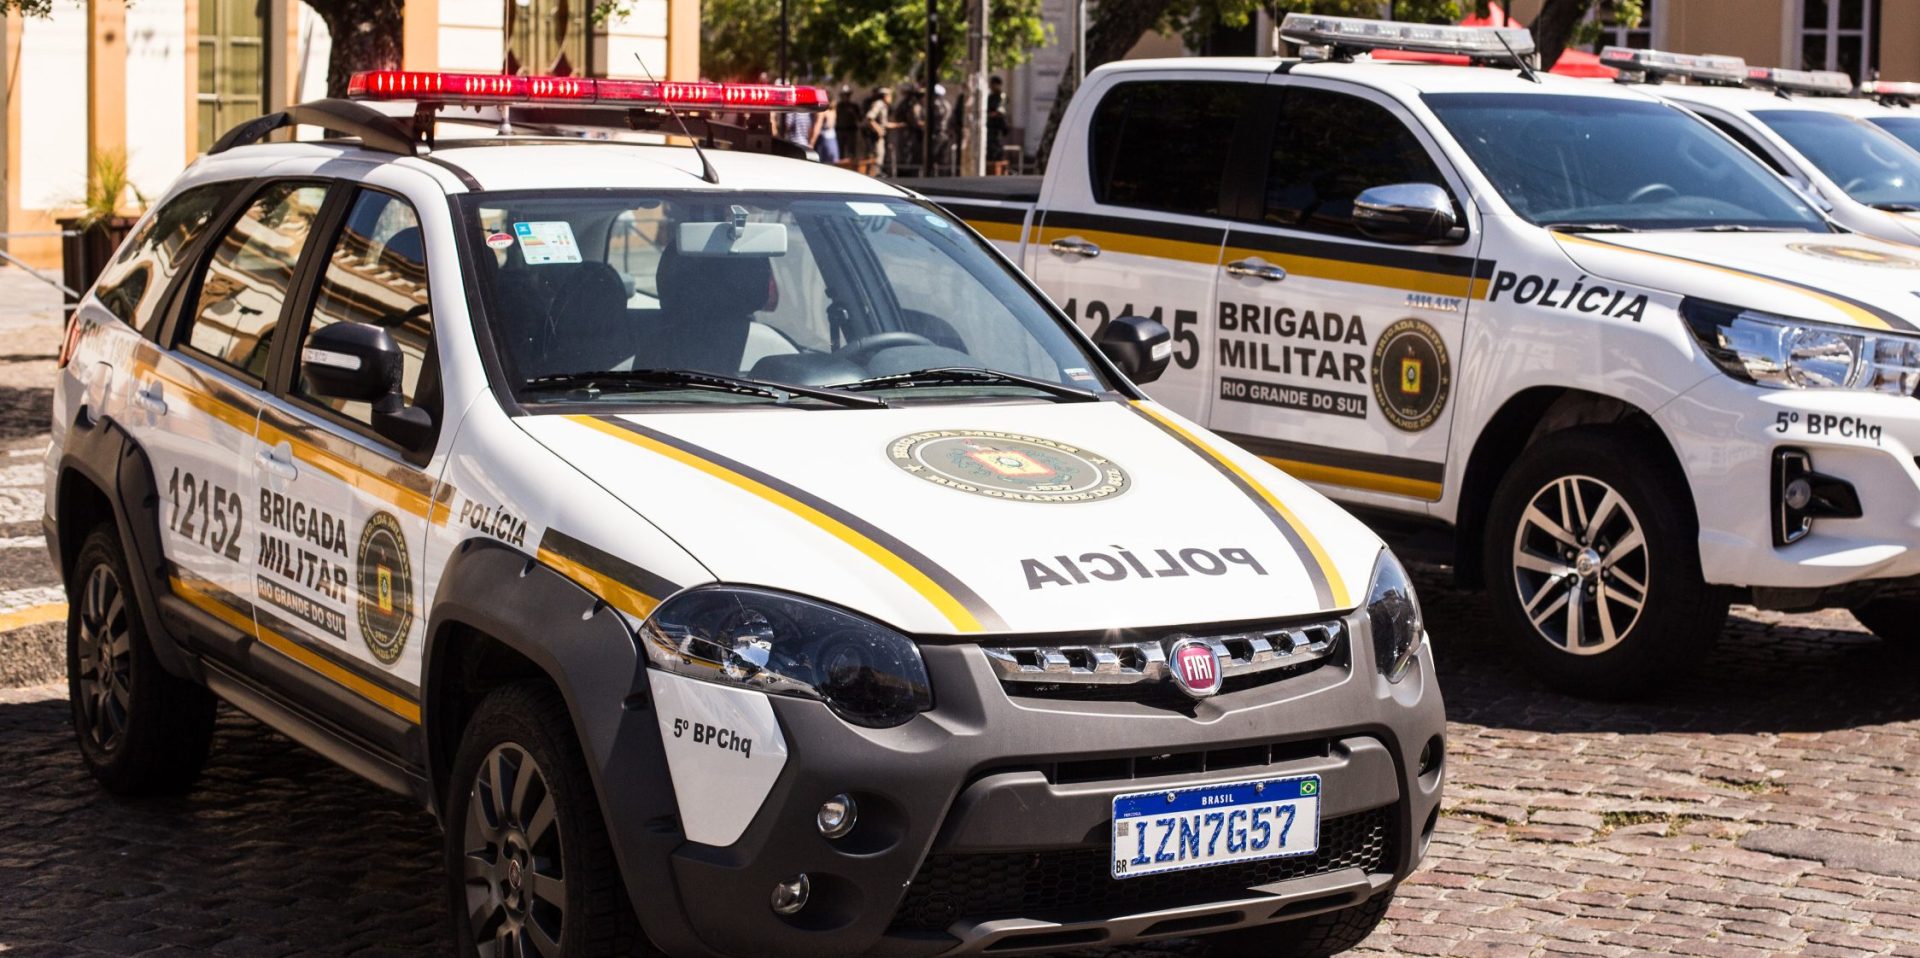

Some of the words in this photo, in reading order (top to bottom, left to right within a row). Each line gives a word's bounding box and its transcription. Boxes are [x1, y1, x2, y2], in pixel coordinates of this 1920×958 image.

[1489, 270, 1649, 322] POLÍCIA
[1219, 301, 1367, 346] BRIGADA
[1219, 338, 1367, 384] MILITAR
[1222, 381, 1246, 397] RIO
[1250, 385, 1308, 406] GRANDE
[1312, 394, 1333, 409] DO
[1336, 397, 1366, 415] SUL
[1807, 413, 1882, 446] BPChq
[169, 466, 243, 563] 12152
[260, 487, 349, 558] BRIGADA
[459, 498, 528, 548] POLÍCIA
[258, 532, 348, 604] MILITAR
[258, 578, 273, 597] RIO
[274, 586, 310, 617] GRANDE
[311, 605, 324, 625] DO
[326, 614, 345, 635] SUL
[1183, 655, 1213, 681] FIAT
[693, 722, 753, 759] BPChq
[1201, 793, 1234, 806] BRASIL
[1130, 804, 1297, 866] IZN7G57
[1116, 859, 1127, 873] BR
